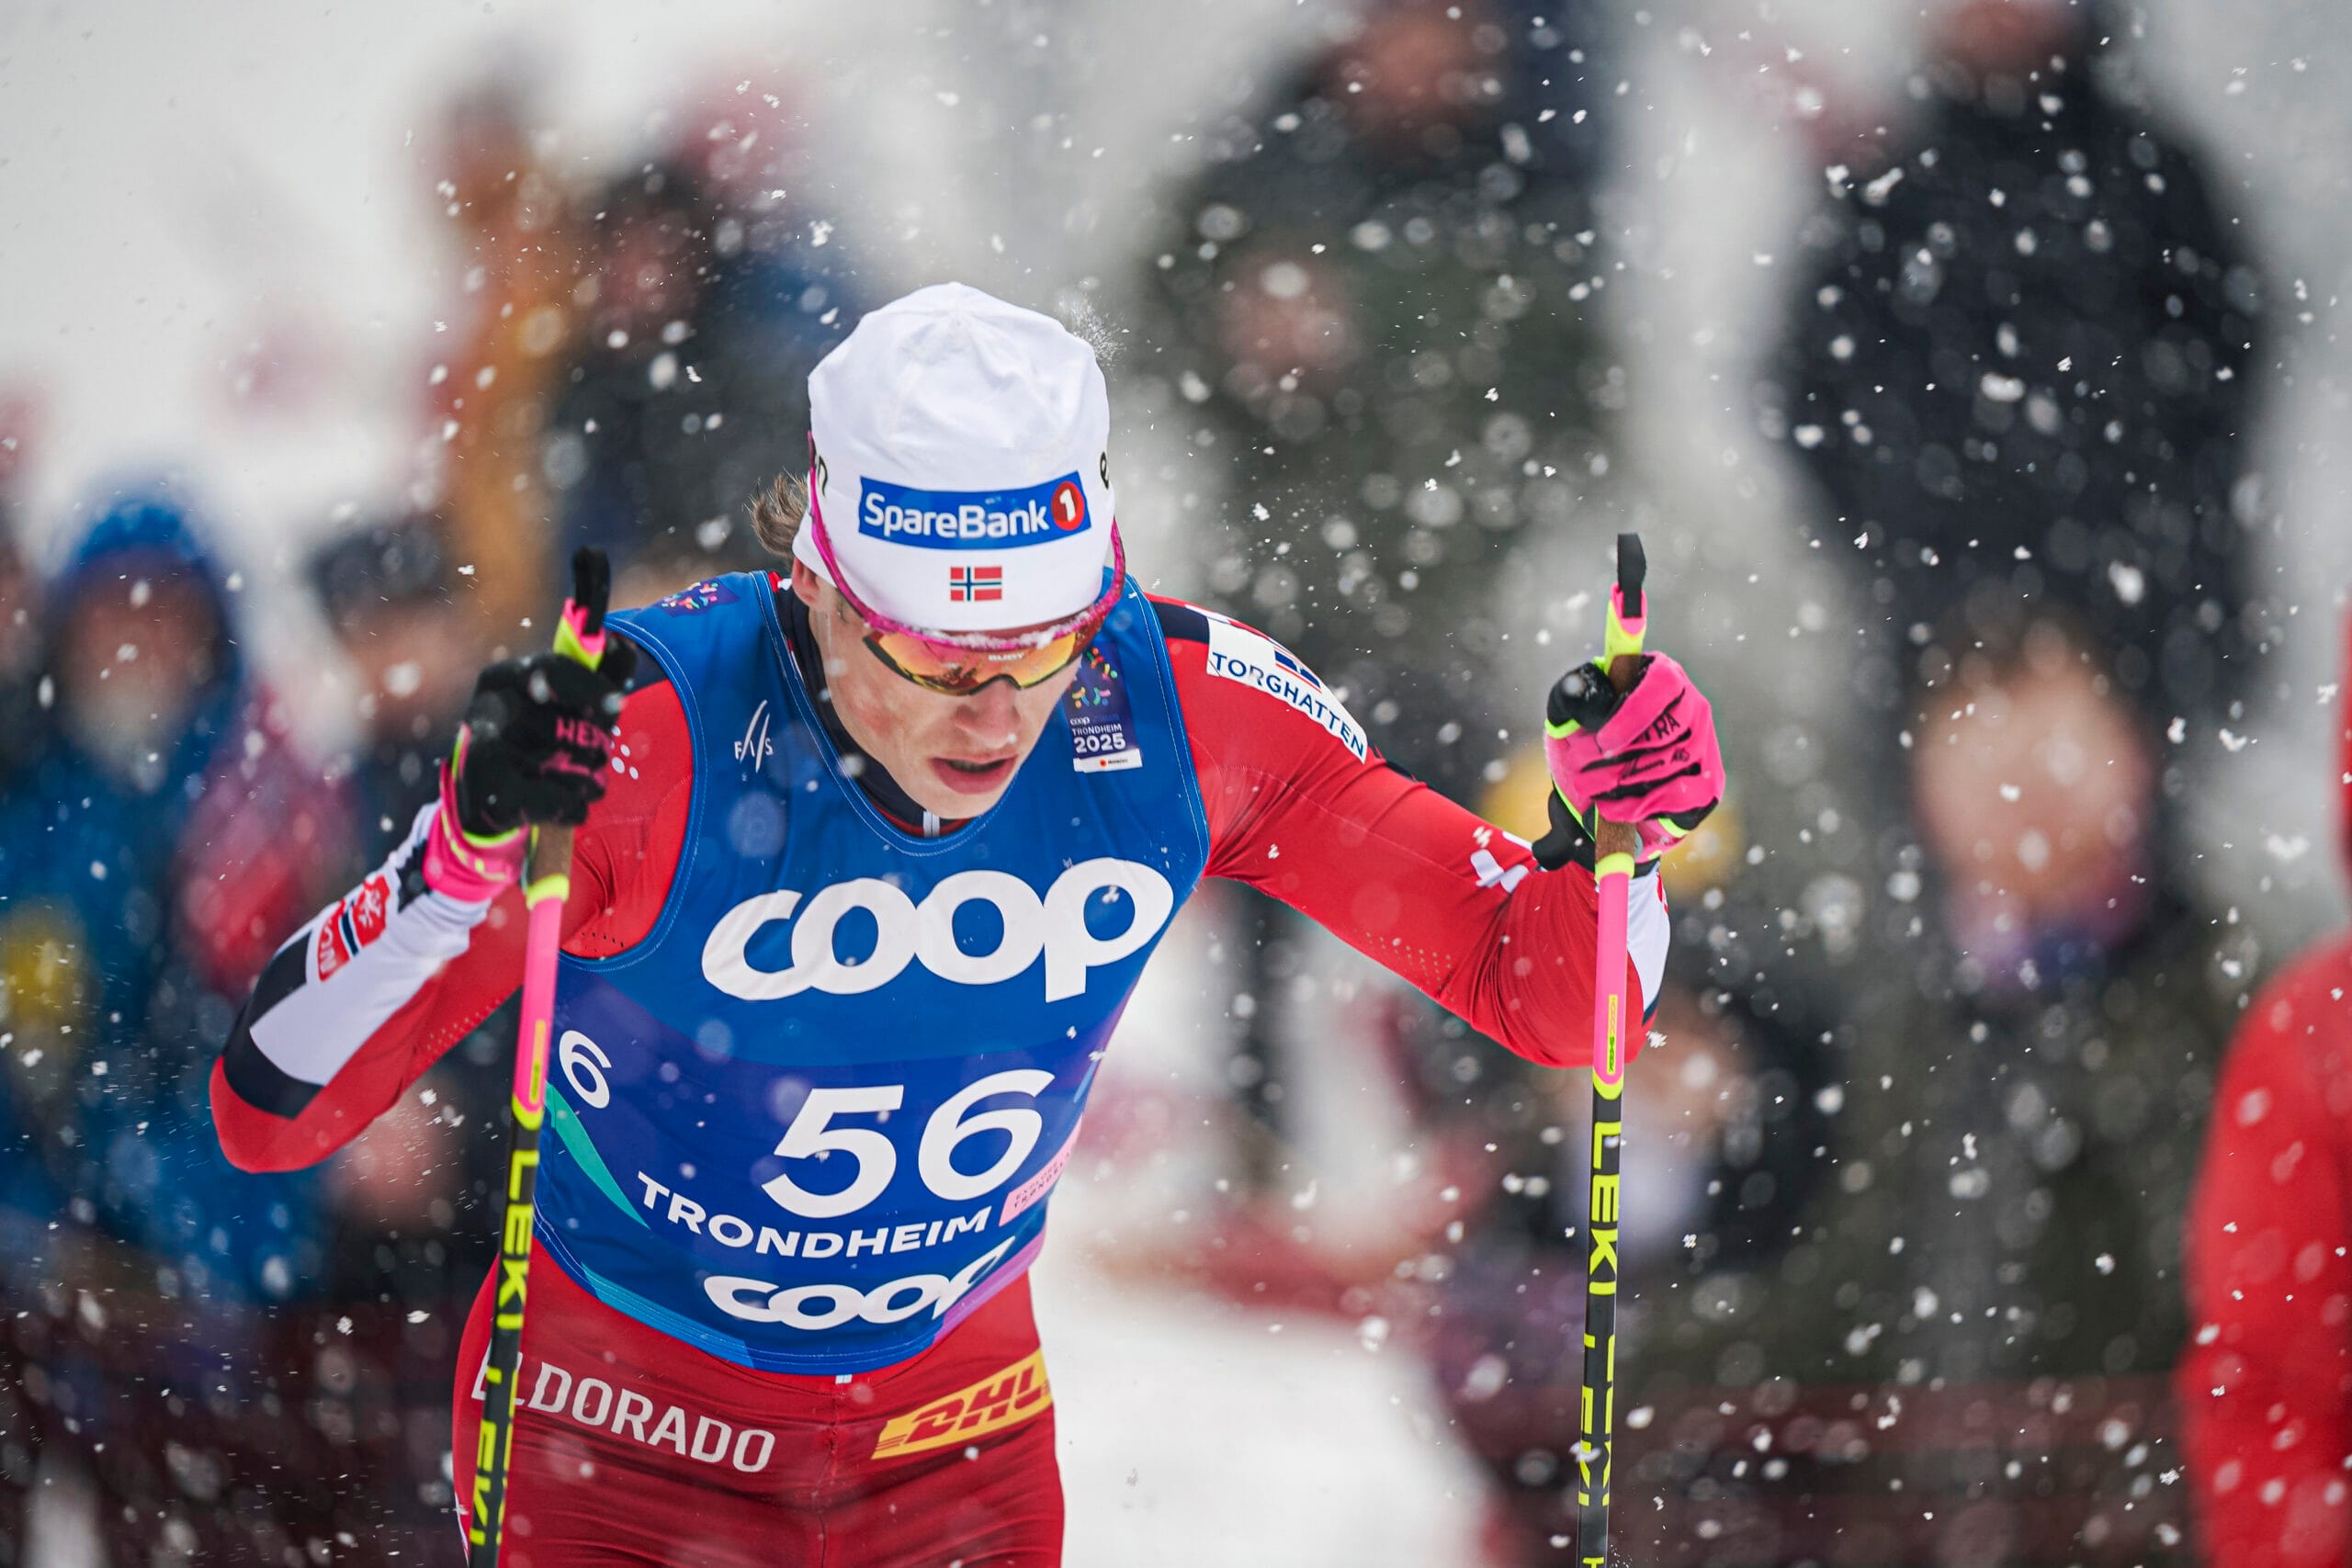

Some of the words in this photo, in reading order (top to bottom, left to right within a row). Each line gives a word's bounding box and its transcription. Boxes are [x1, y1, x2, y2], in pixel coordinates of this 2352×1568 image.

[864, 491, 1049, 540] SpareBank
[1058, 489, 1077, 523] 1
[1071, 723, 1123, 736] TRONDHEIM
[1073, 732, 1126, 753] 2025
[1212, 650, 1365, 758] TORGHATTEN
[701, 856, 1174, 1003] coop
[761, 1068, 1057, 1219] 56
[496, 1149, 540, 1330] LEKI
[637, 1170, 992, 1259] TRONDHEIM
[1589, 1121, 1622, 1296] LEKI
[904, 1365, 1043, 1445] DHL
